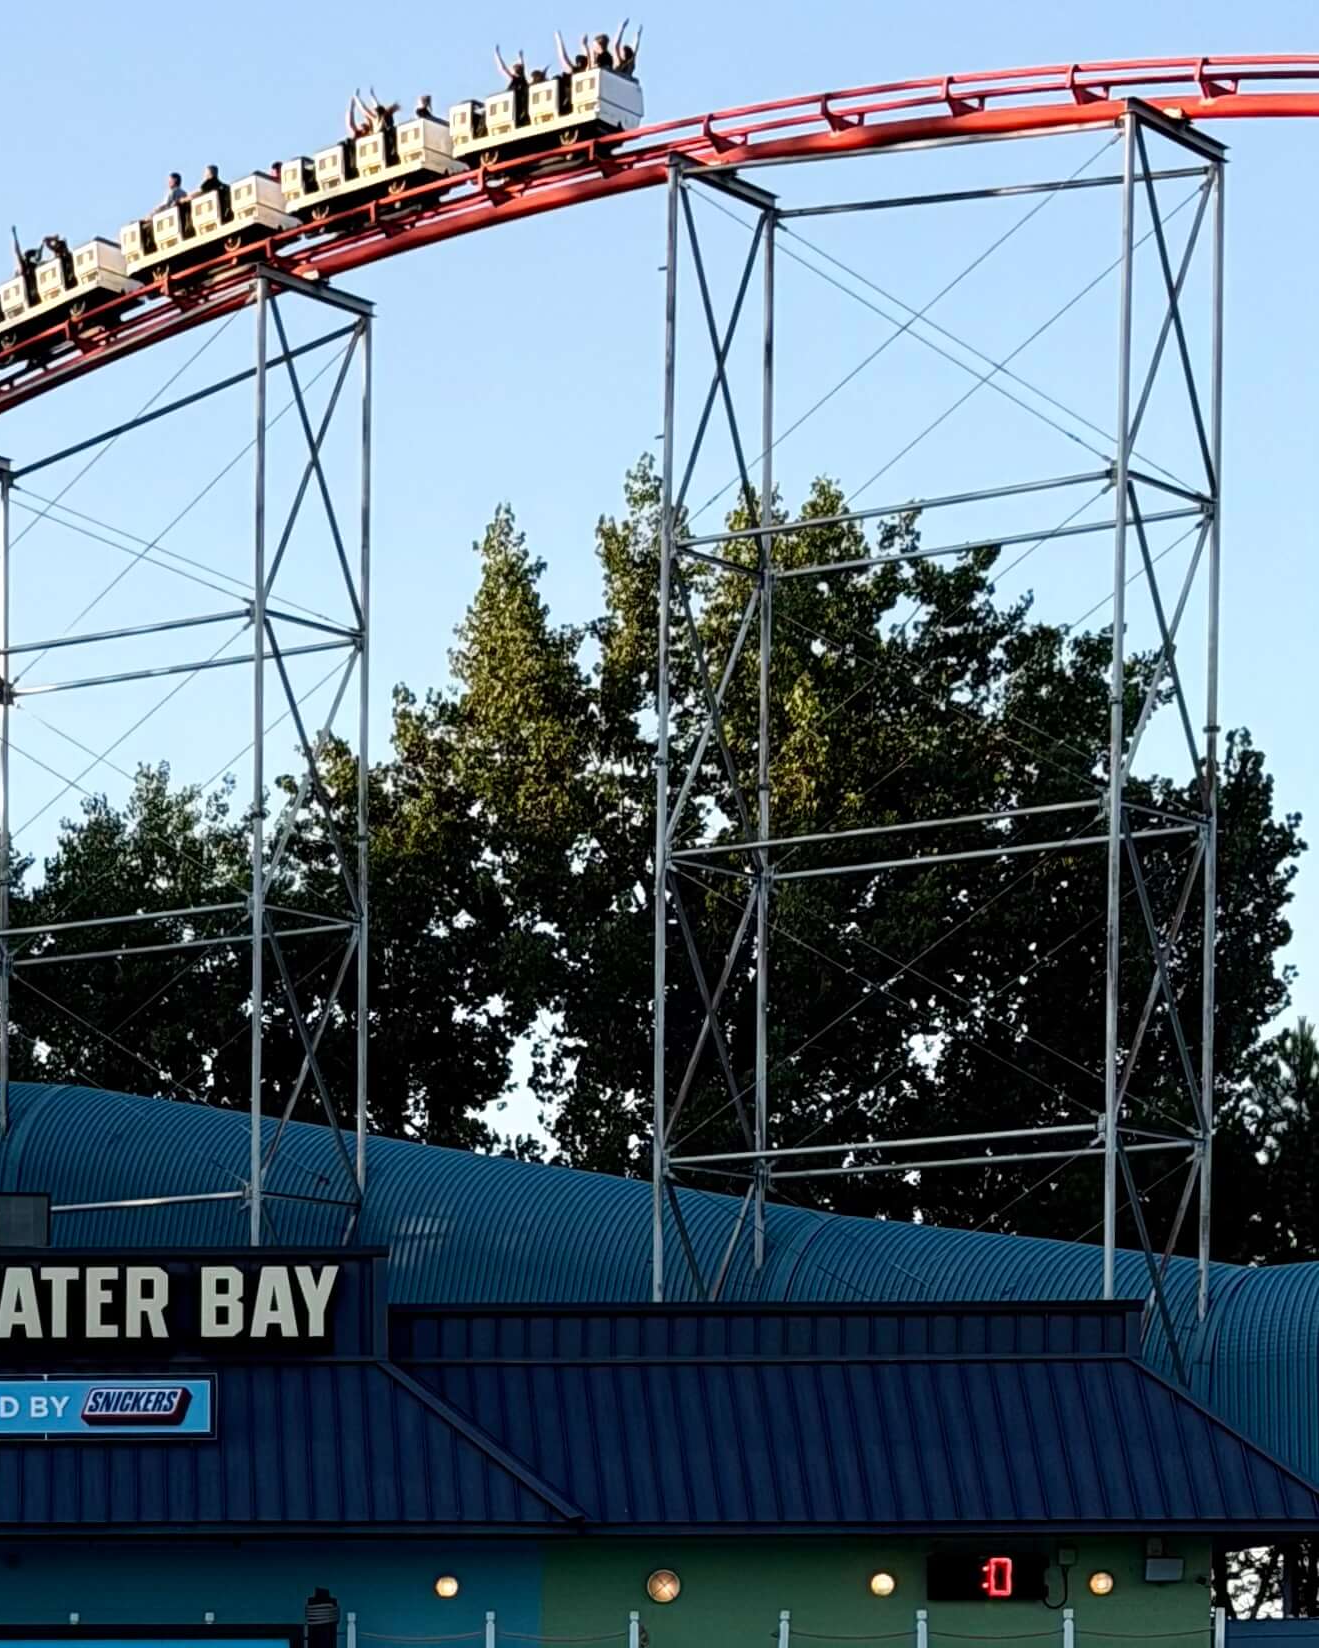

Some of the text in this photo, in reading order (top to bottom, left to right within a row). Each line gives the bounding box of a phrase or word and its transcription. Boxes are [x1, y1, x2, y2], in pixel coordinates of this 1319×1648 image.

[200, 1265, 339, 1338] BAY
[29, 1395, 70, 1418] BY
[87, 1389, 179, 1414] SNICKERS
